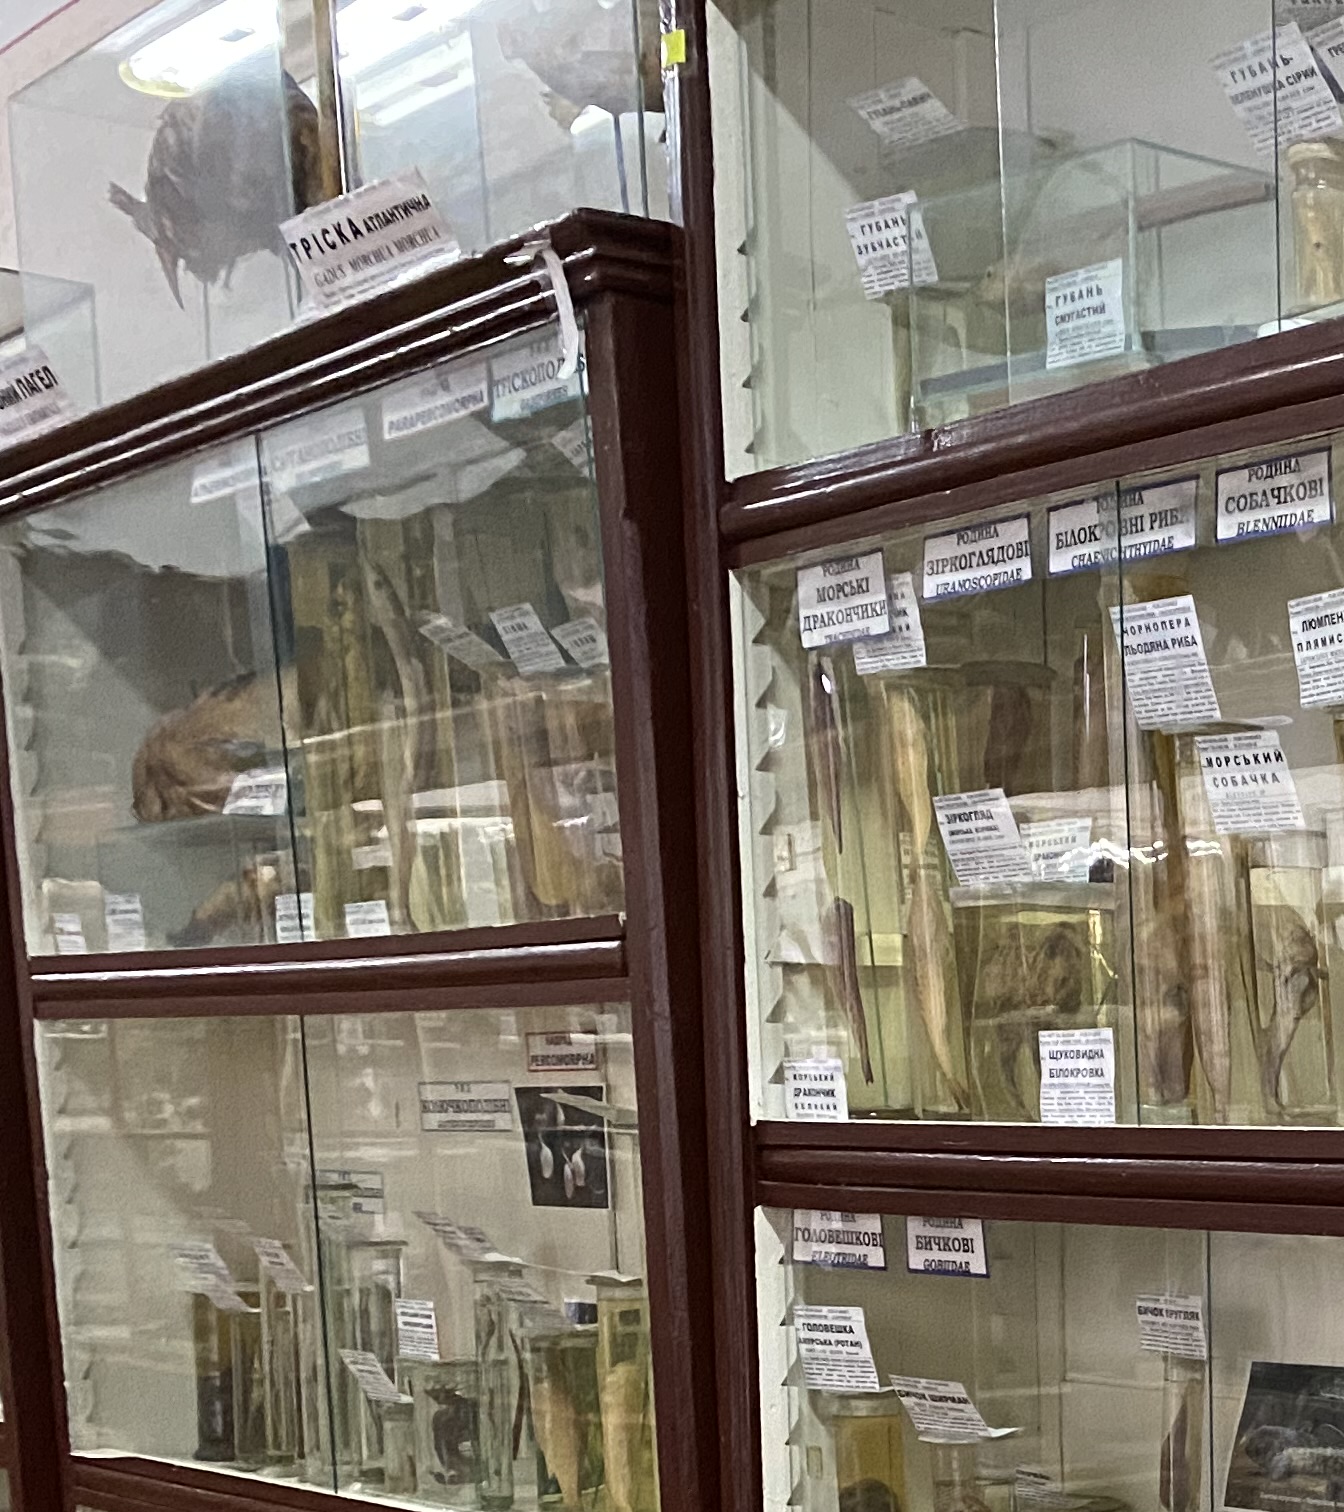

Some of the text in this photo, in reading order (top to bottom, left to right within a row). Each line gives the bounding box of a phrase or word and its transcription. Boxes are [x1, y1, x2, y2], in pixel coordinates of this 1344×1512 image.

[289, 193, 431, 264] ТРІСКА АТЛАНТИЧНА
[1056, 284, 1103, 308] ГУБАНЬ
[15, 366, 58, 399] ПАГЕЛ
[1247, 457, 1303, 483] РОДИНА
[1225, 478, 1324, 515] СОБАЧКОВІ
[926, 540, 1030, 577] ЗІРКОГЛЯДОВІ
[816, 577, 870, 604] МОРСЬКІ
[1171, 635, 1198, 649] РИБА
[1206, 749, 1284, 768] МОРСЬКИЙ
[1213, 773, 1280, 788] СОБАЧКА
[1048, 1048, 1105, 1061] ЩУКОВИДНА
[1048, 1067, 1105, 1079] БІЛОКРОВКА
[795, 1227, 883, 1248] ГОЛОВЕШКОВІ
[915, 1234, 975, 1254] БИЧКОВІ
[802, 1322, 855, 1335] ГОЛОВЕШКА
